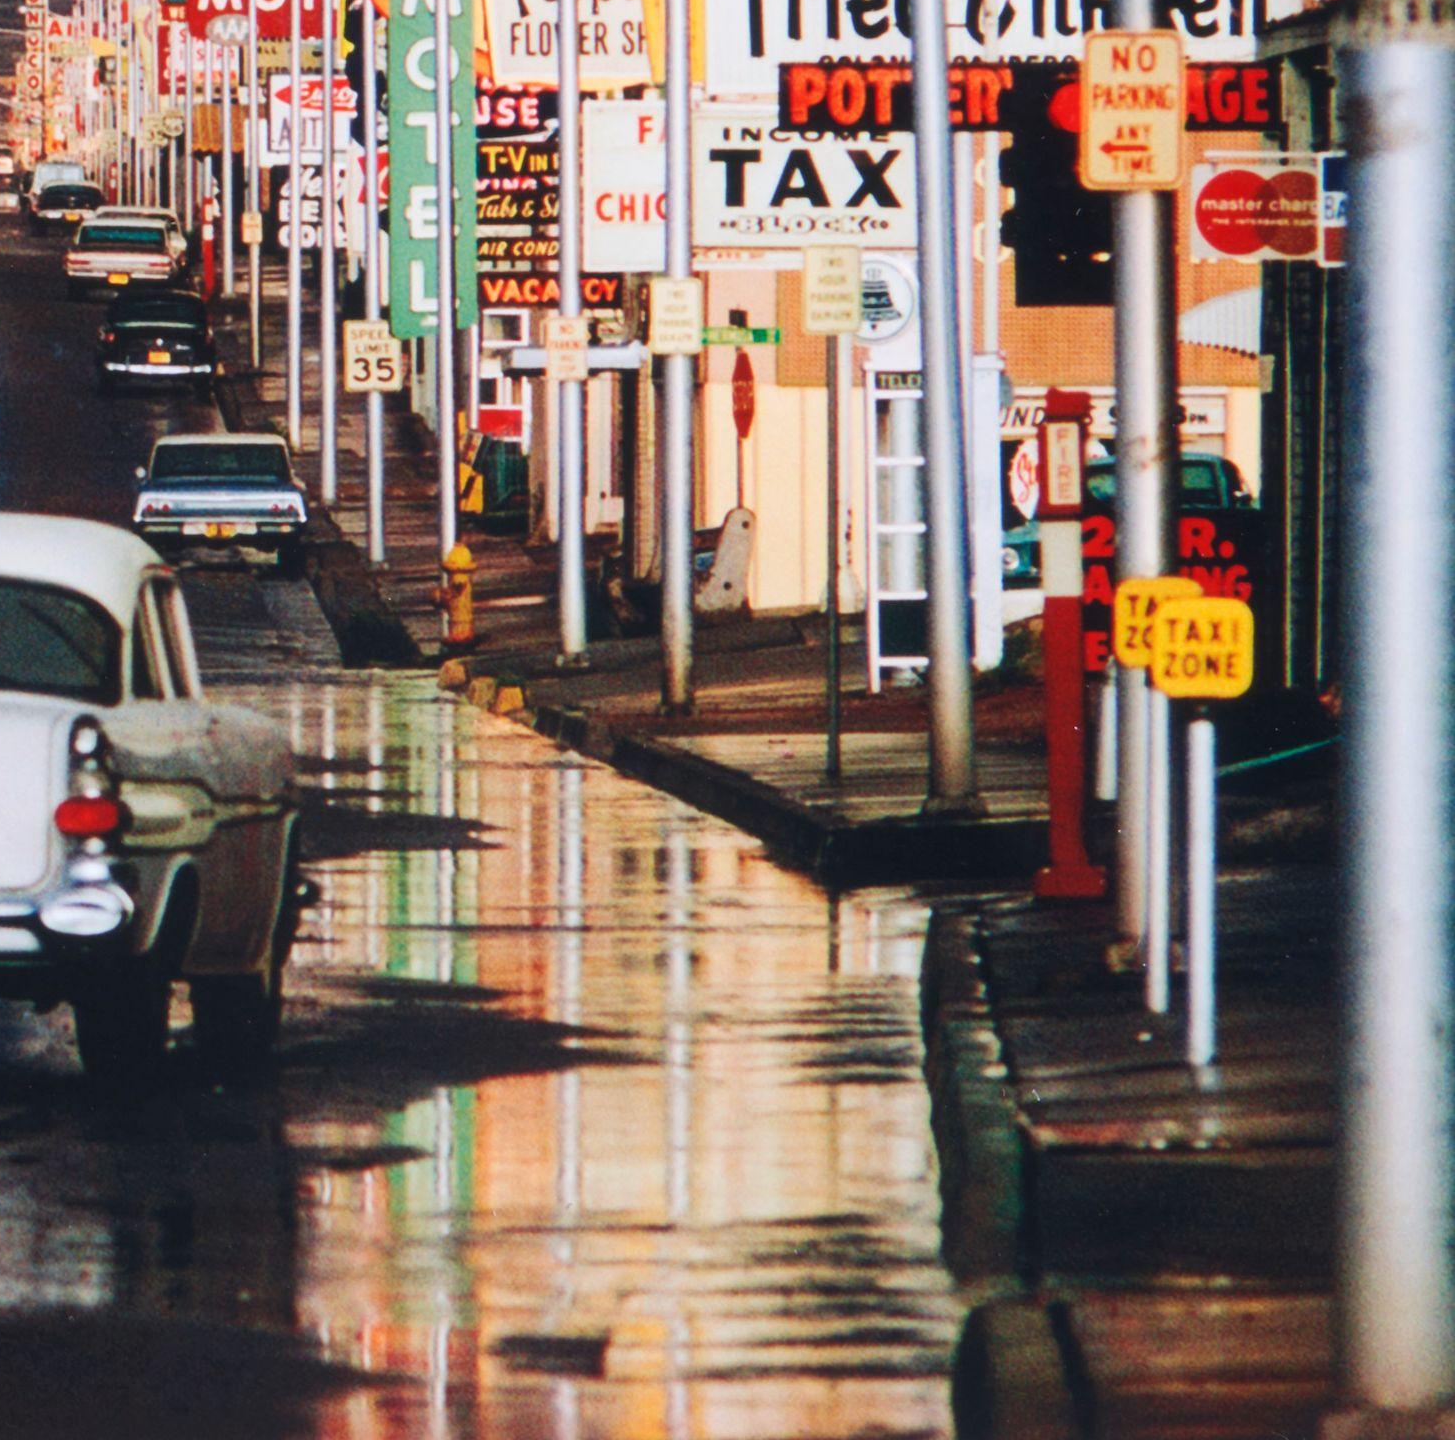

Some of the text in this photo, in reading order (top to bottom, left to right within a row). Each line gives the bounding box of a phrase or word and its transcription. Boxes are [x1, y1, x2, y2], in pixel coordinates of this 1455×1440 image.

[510, 21, 609, 57] FLOER
[1111, 44, 1158, 74] NO
[1093, 83, 1174, 110] PARKING
[1114, 125, 1151, 142] ANY
[709, 149, 904, 208] TAX
[1112, 156, 1157, 175] TIME
[1200, 197, 1264, 213] master
[482, 279, 619, 303] VACACY
[352, 357, 396, 383] 35
[1165, 618, 1245, 643] TAXI
[1164, 653, 1238, 679] ZONE
